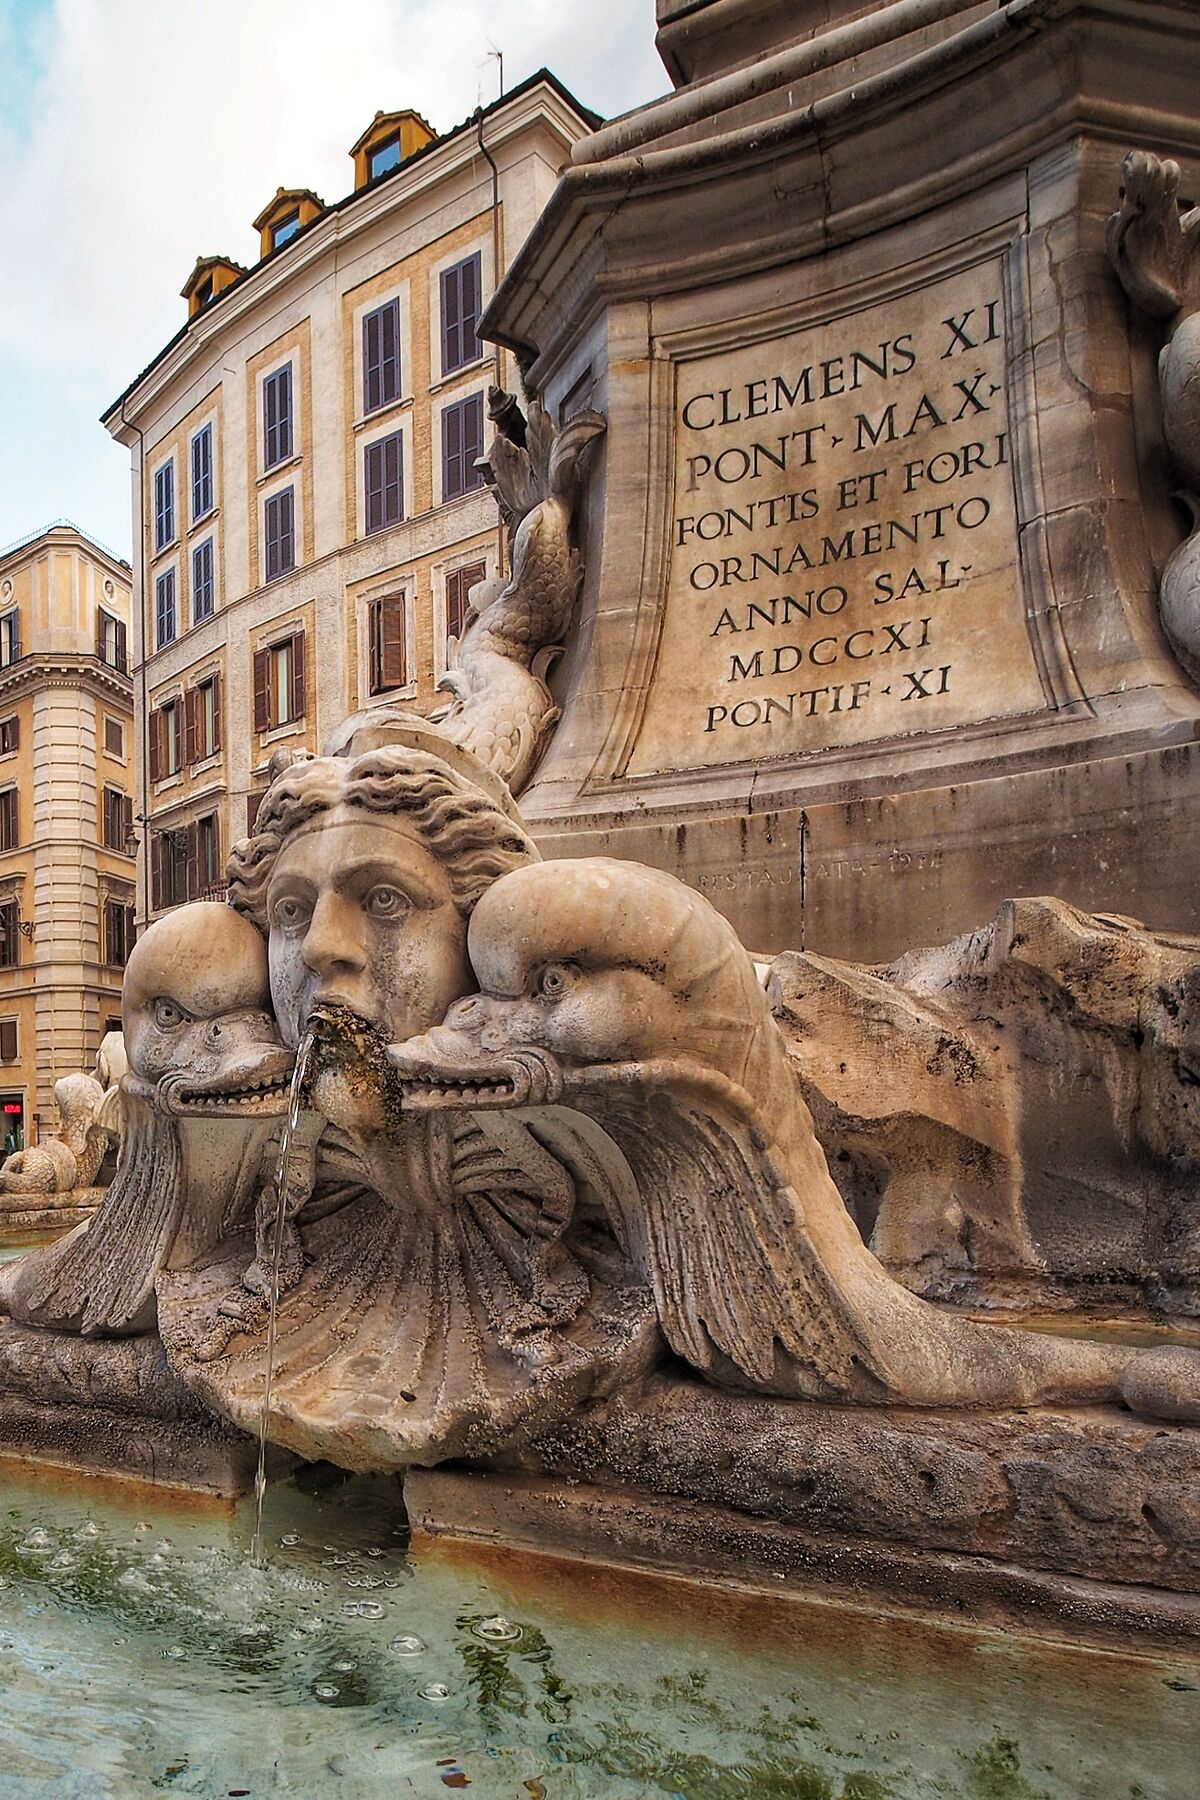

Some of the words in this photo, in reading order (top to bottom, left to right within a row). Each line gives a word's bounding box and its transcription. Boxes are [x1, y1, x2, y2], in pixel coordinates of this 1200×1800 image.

[681, 333, 916, 432] CLEMENS
[940, 299, 1002, 359] XI
[675, 488, 820, 547] FONTIS
[836, 469, 887, 511] ET
[903, 433, 1009, 494] FORI
[689, 496, 991, 591] ORNAMENTO
[710, 586, 849, 637] ANNO
[727, 617, 932, 683] MDCCXI
[900, 665, 951, 702] XI
